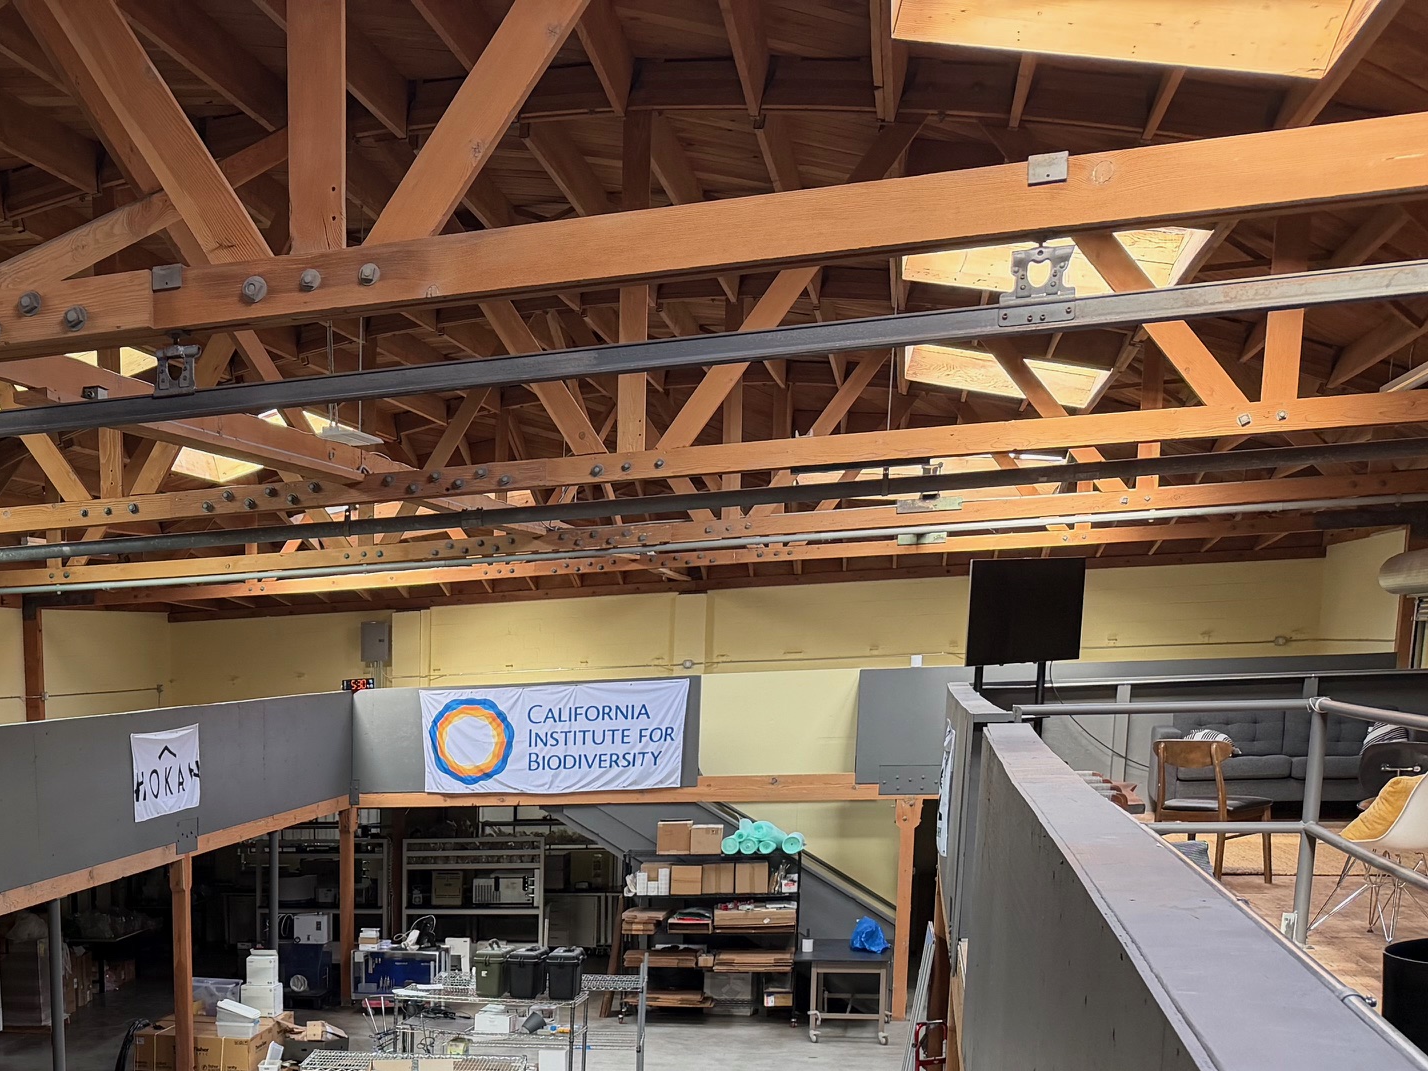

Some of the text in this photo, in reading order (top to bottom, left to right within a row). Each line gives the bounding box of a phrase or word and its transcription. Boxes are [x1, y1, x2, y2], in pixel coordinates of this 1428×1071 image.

[527, 703, 651, 725] CALIFORNIA
[528, 726, 675, 748] INSTITUTE FOR
[528, 750, 663, 772] BIODIVERSITY
